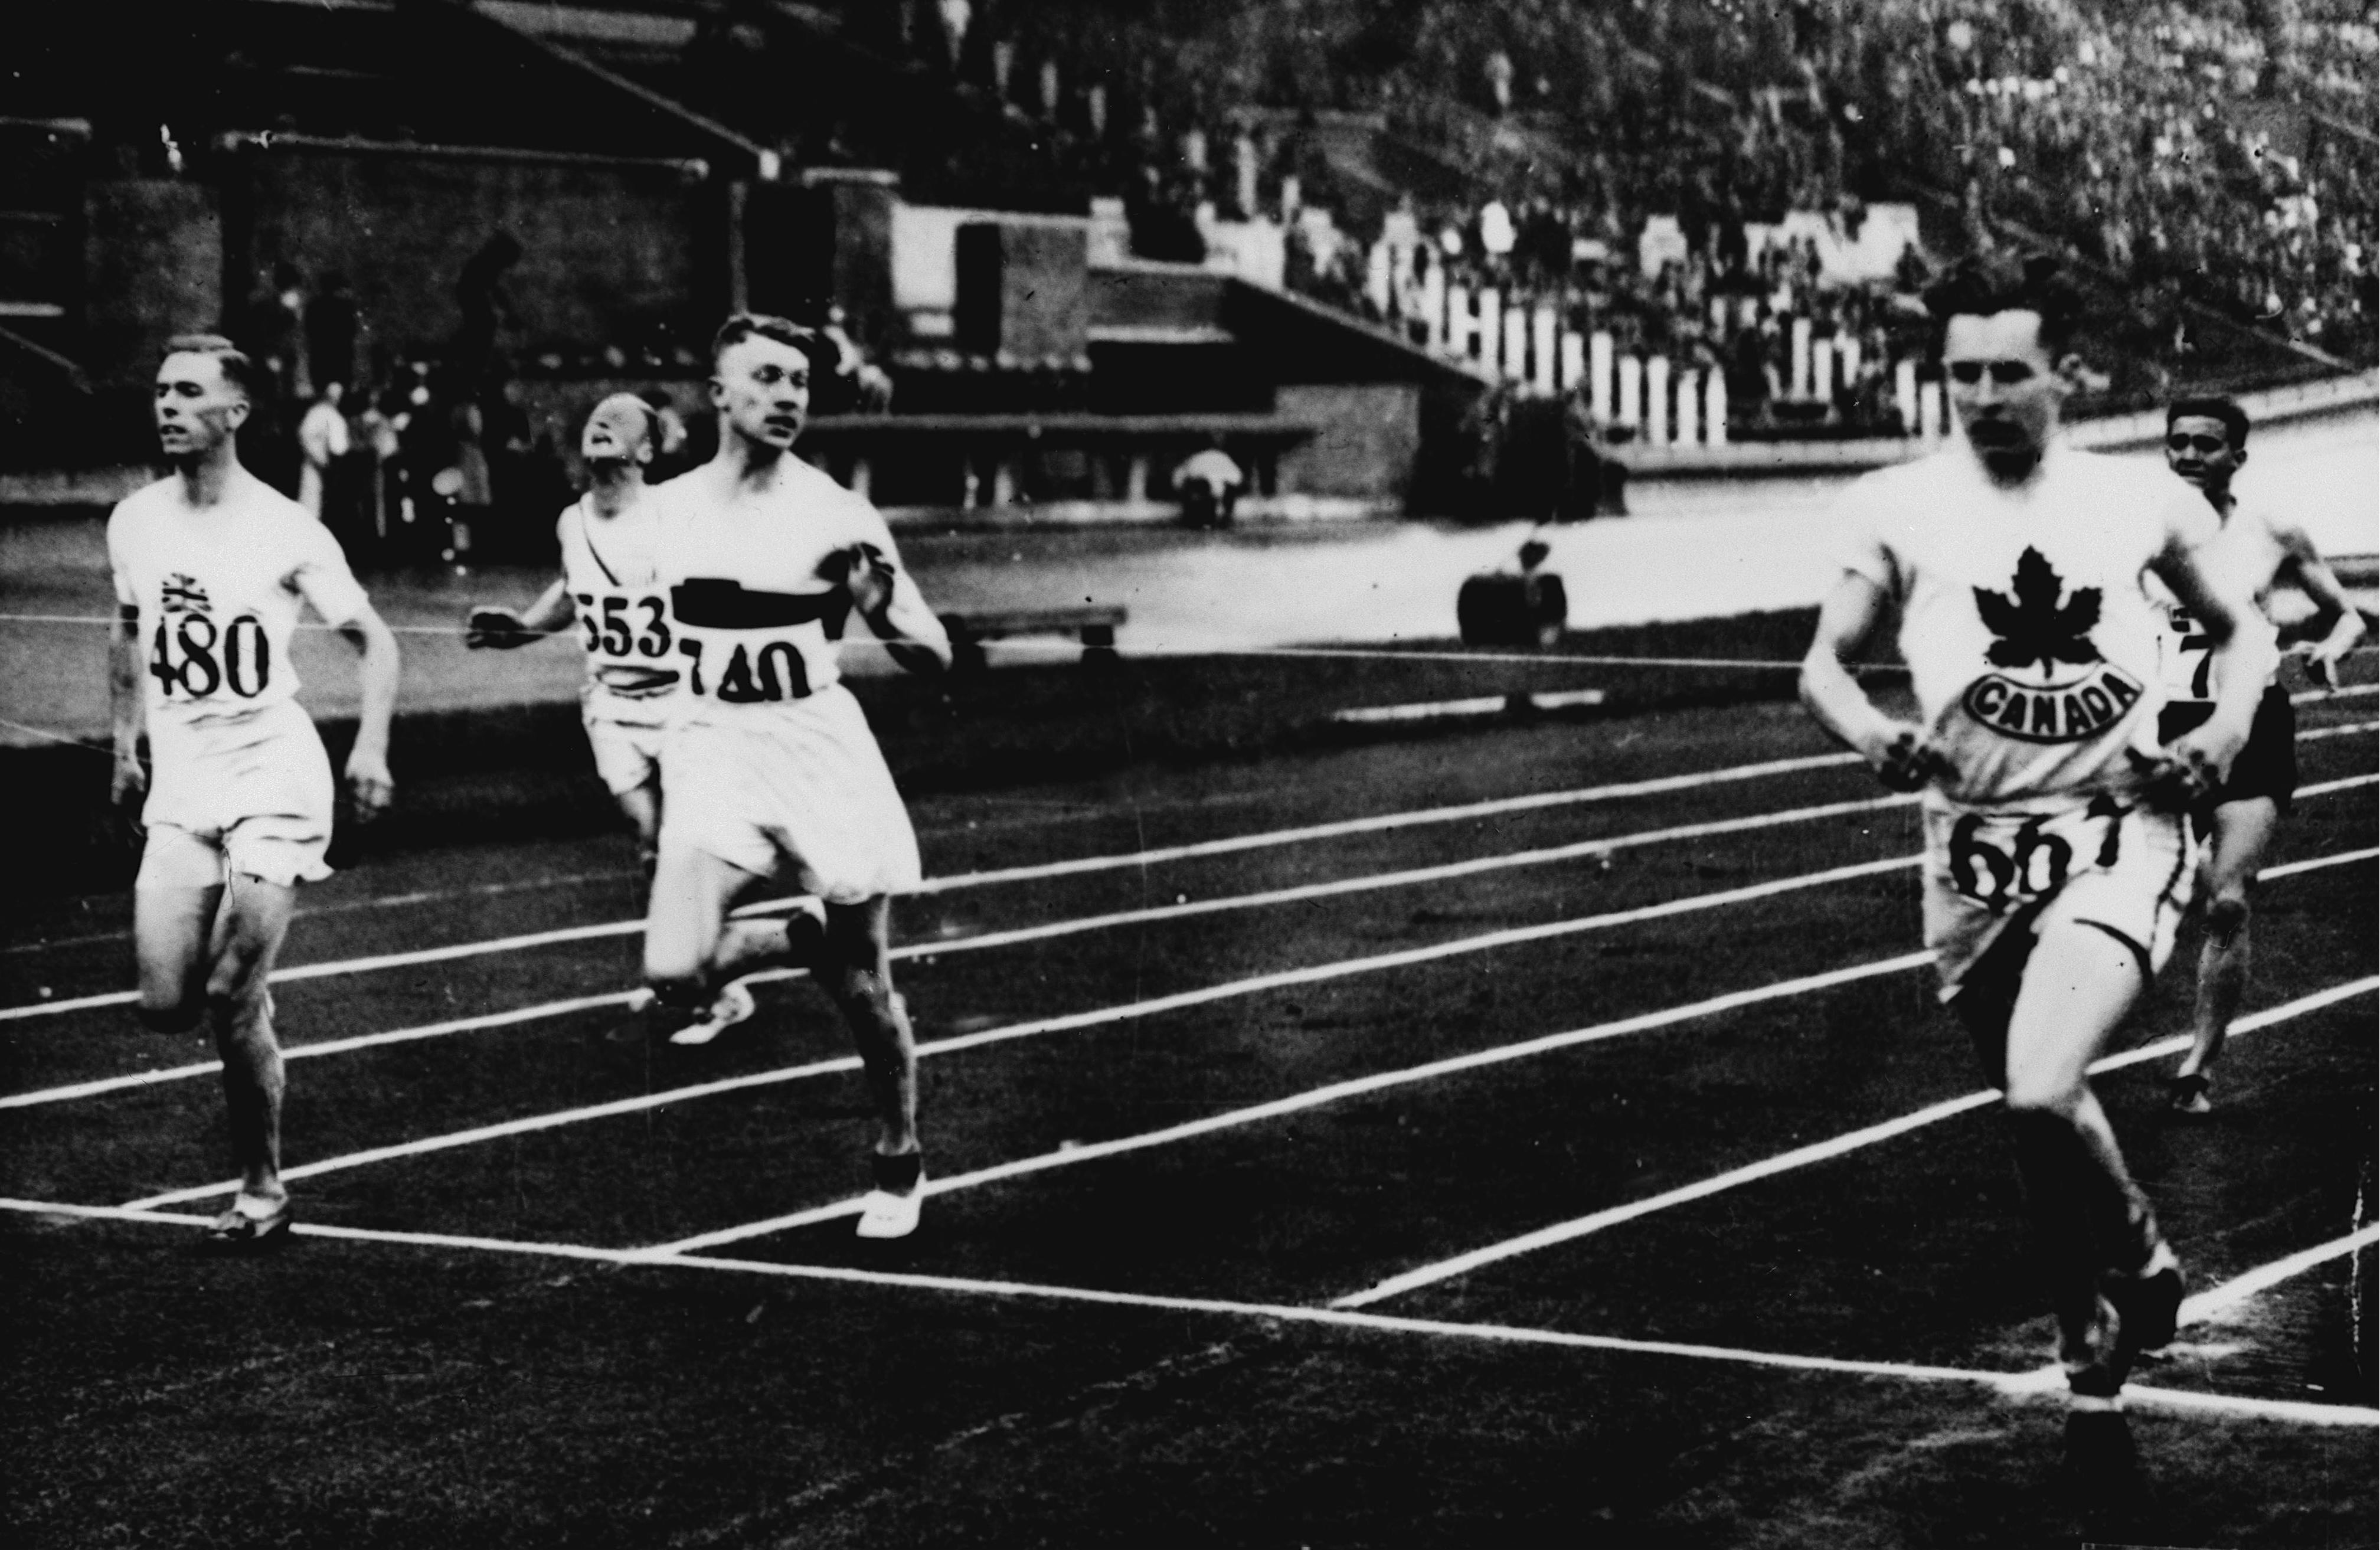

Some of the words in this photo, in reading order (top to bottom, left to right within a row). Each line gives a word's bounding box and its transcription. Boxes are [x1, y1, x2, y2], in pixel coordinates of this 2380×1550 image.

[149, 614, 269, 698] 480
[678, 638, 812, 703] 740
[1973, 672, 2142, 735] CANADA
